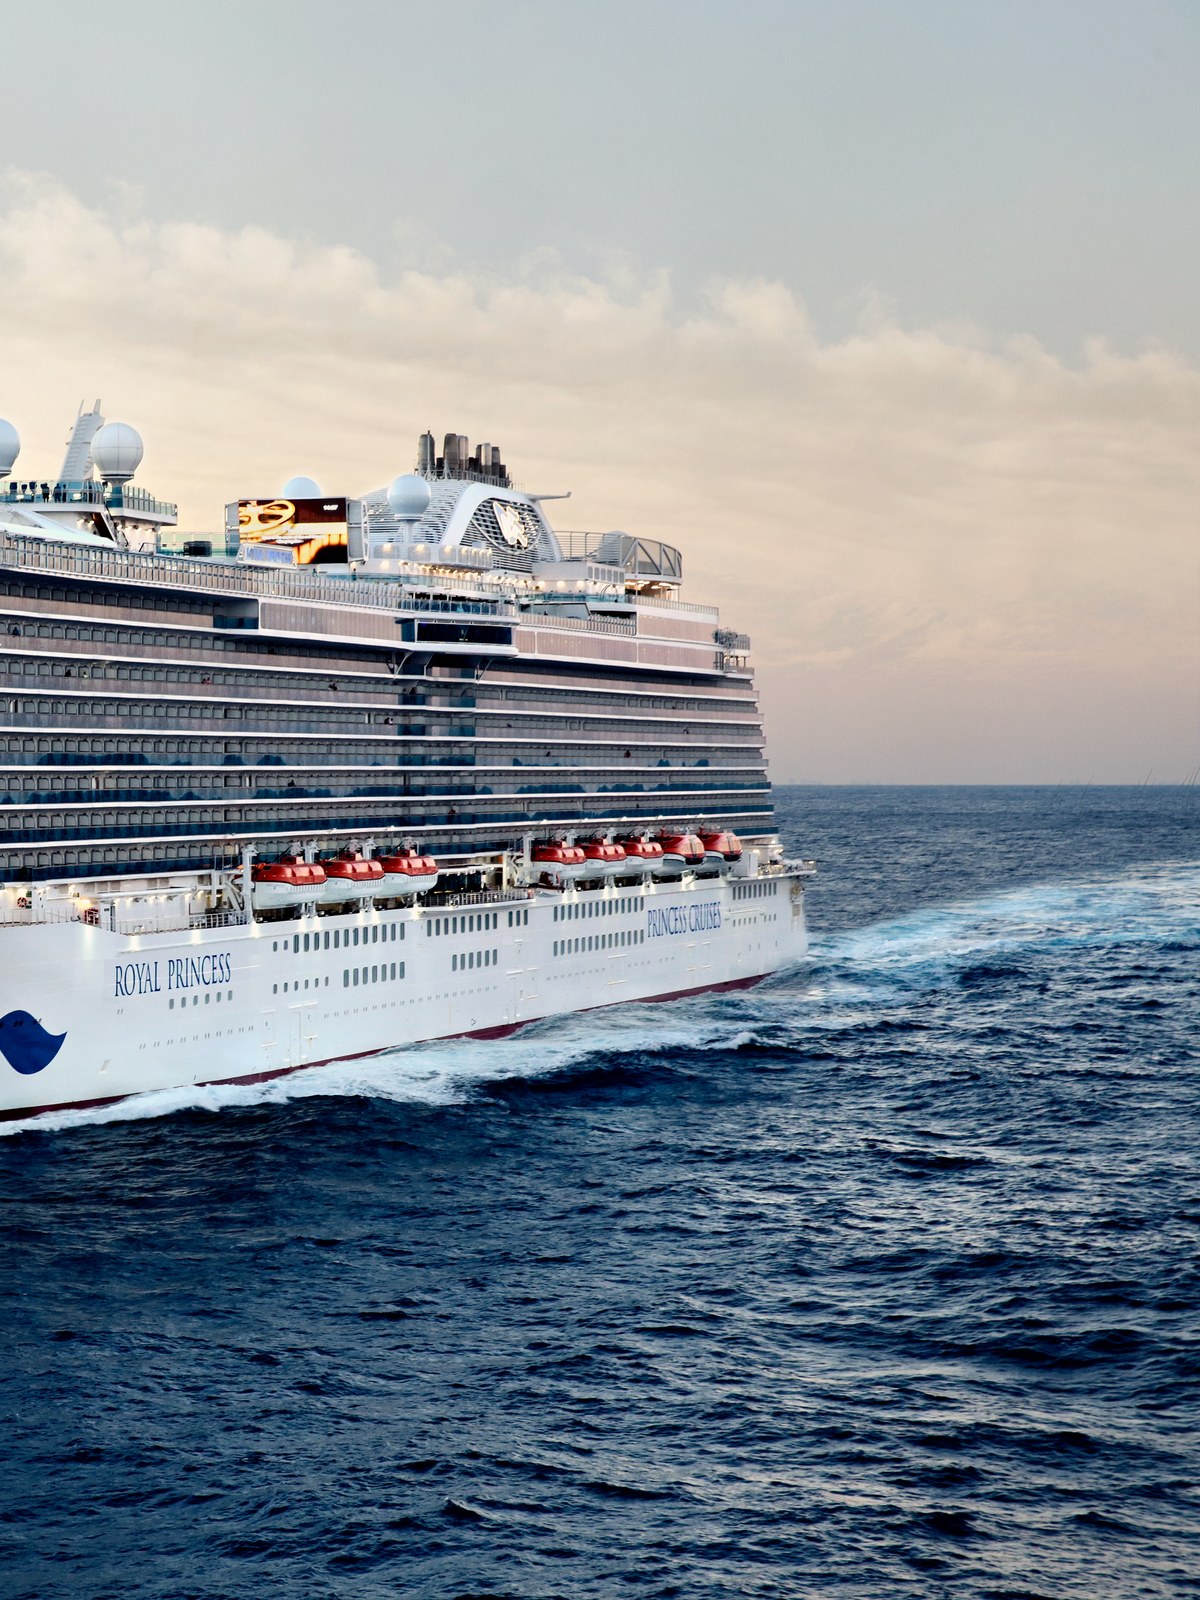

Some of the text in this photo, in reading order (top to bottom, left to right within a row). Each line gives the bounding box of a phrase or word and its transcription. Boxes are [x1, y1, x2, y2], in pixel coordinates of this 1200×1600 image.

[647, 901, 721, 938] PRINCESS CRUISES
[114, 952, 231, 997] ROYAL PRINCESS
